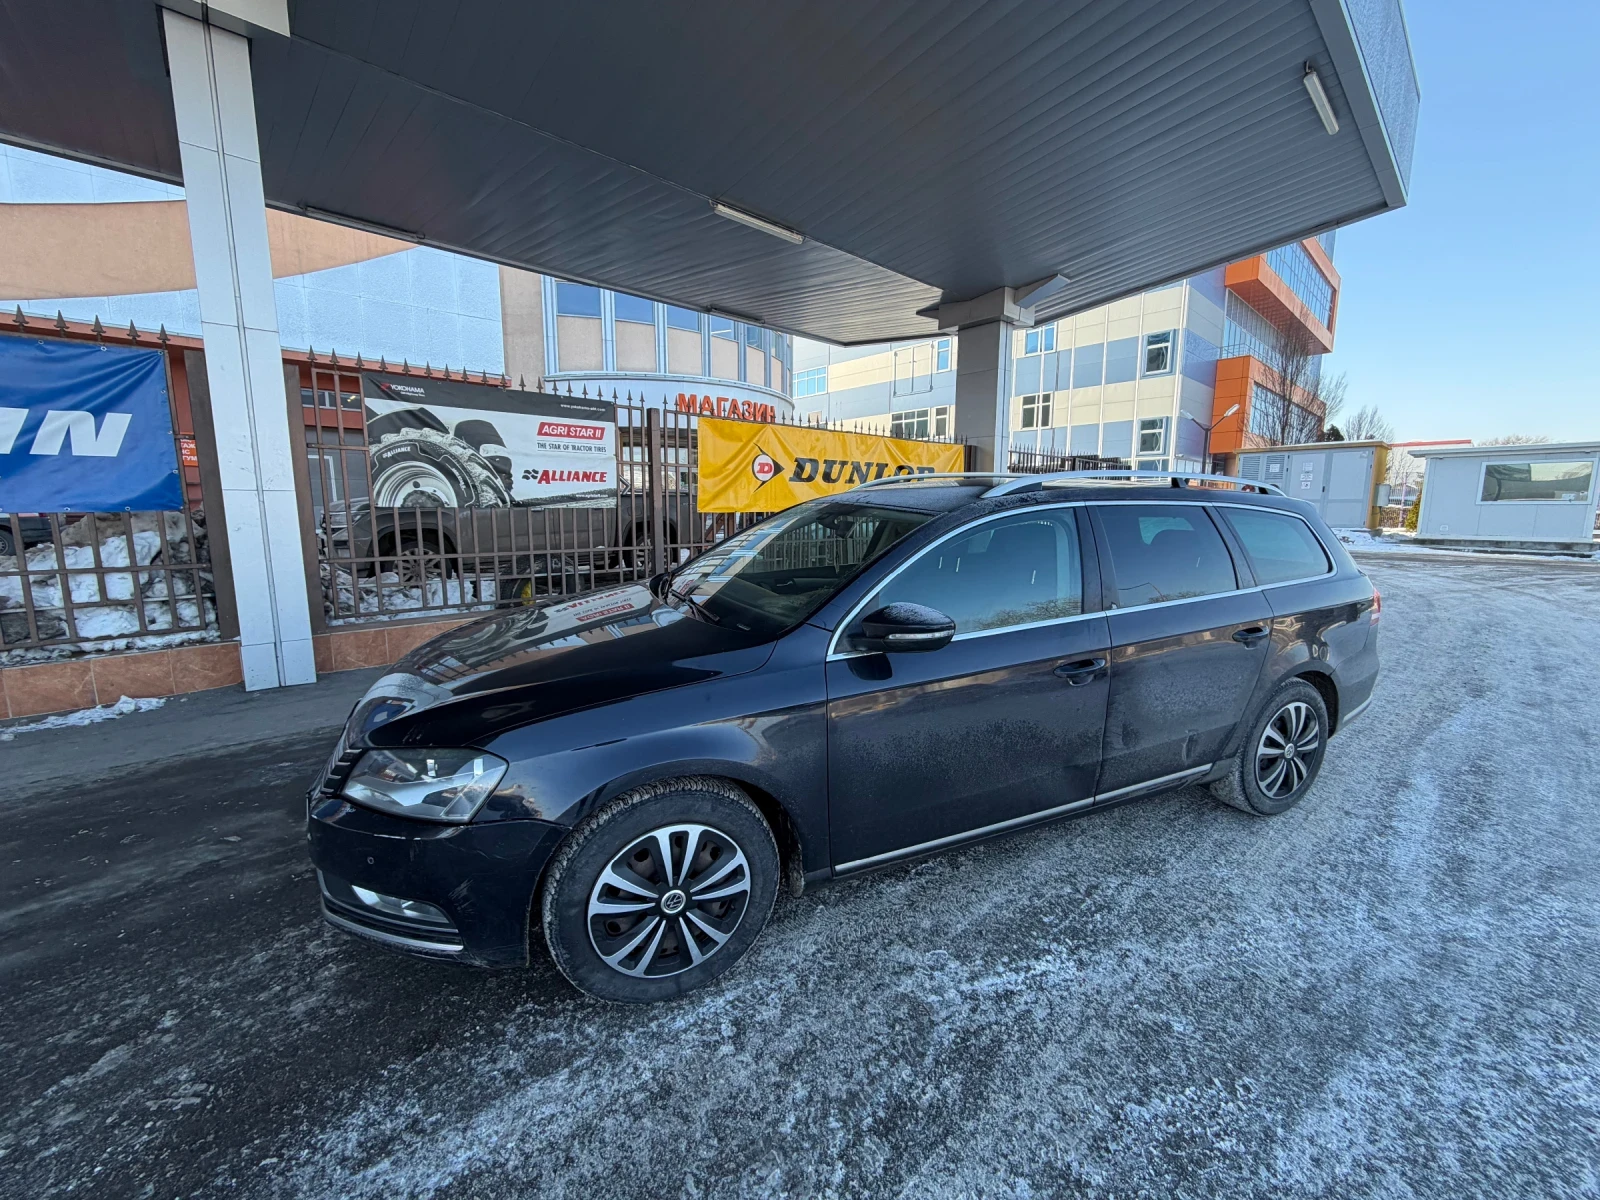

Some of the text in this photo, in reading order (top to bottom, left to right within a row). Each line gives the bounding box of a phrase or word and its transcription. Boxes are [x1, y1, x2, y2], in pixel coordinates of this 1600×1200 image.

[390, 384, 425, 393] YOKOHAMA
[677, 393, 776, 423] МАГАЗИН
[541, 424, 602, 438] AGRI STAR II
[571, 444, 593, 452] TRACTOR
[537, 469, 608, 485] ALLIANCE
